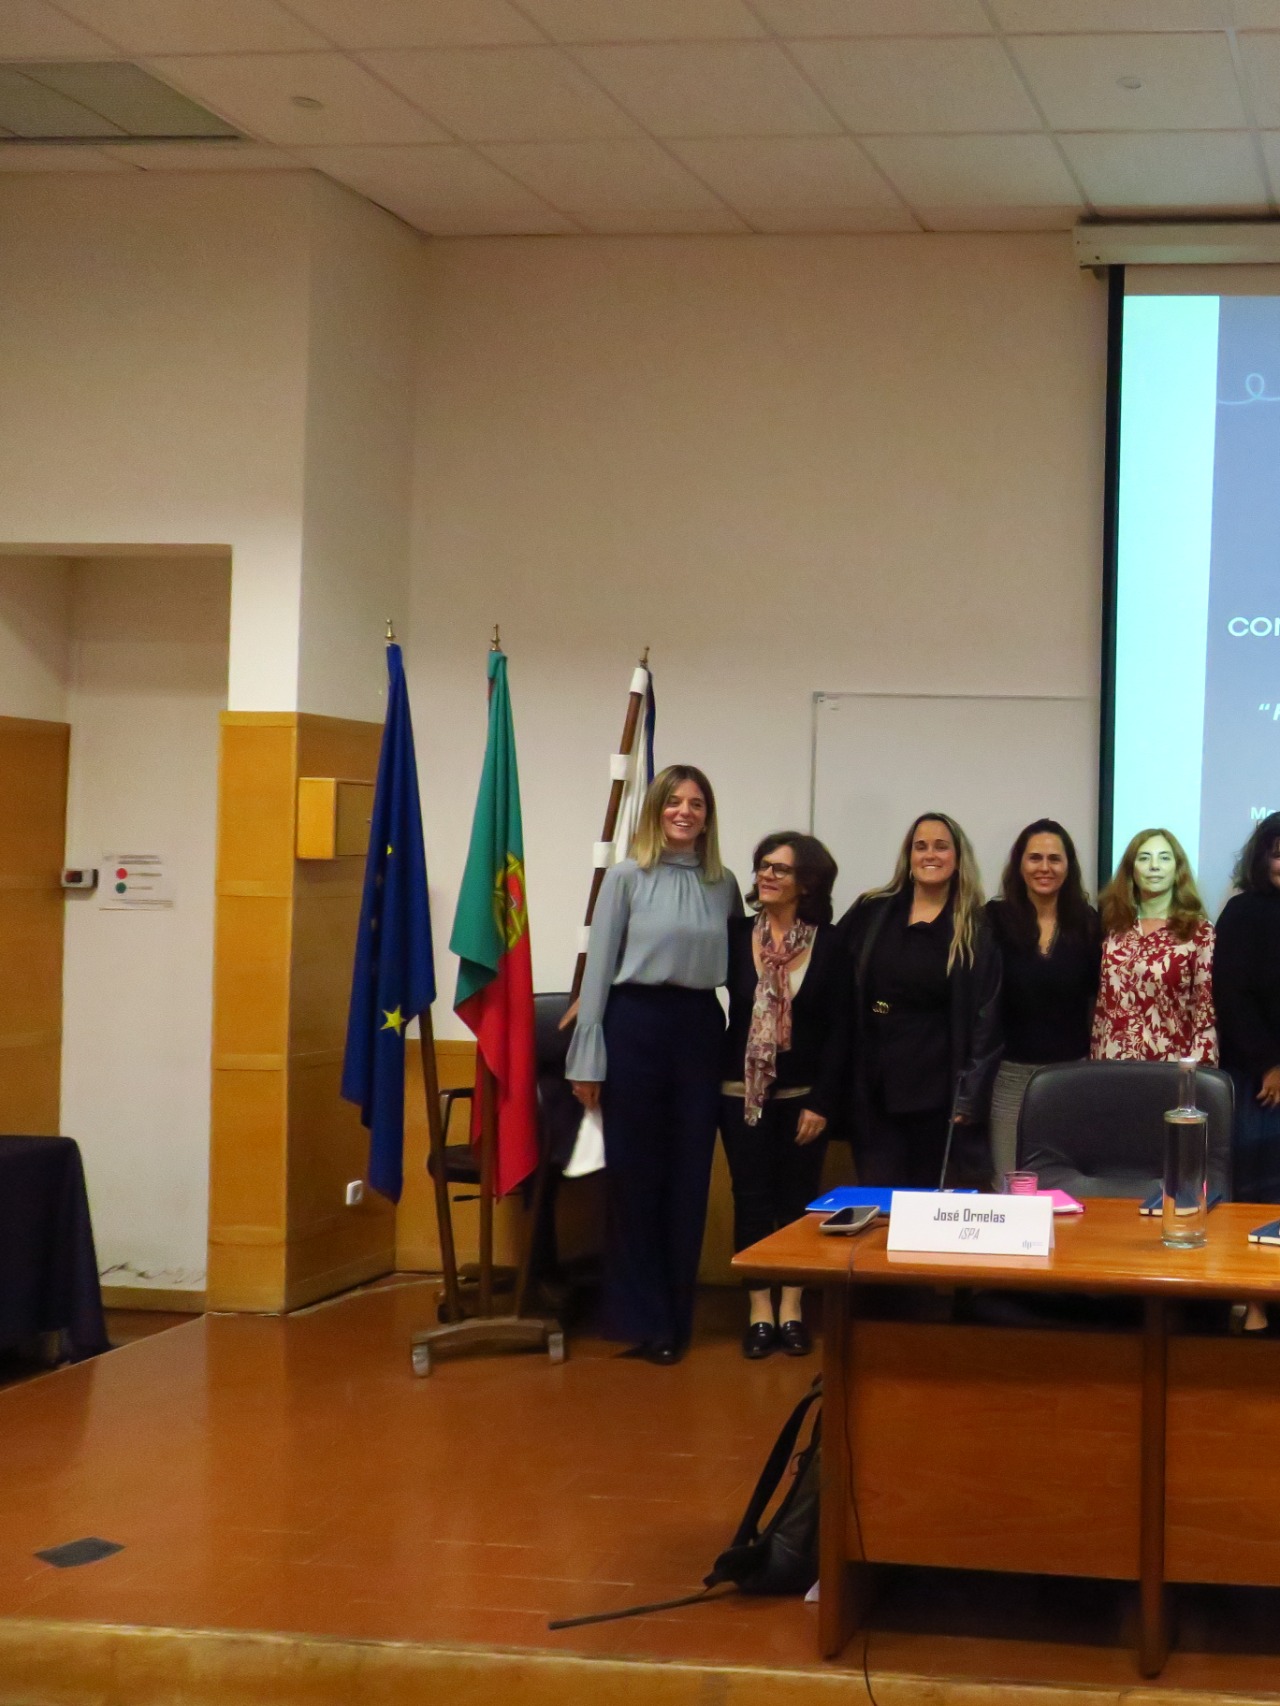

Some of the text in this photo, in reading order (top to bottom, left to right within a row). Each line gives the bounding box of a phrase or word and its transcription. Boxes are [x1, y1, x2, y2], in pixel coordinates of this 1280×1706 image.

[933, 1207, 1006, 1224] José Ornelas
[958, 1227, 981, 1240] ISPA
